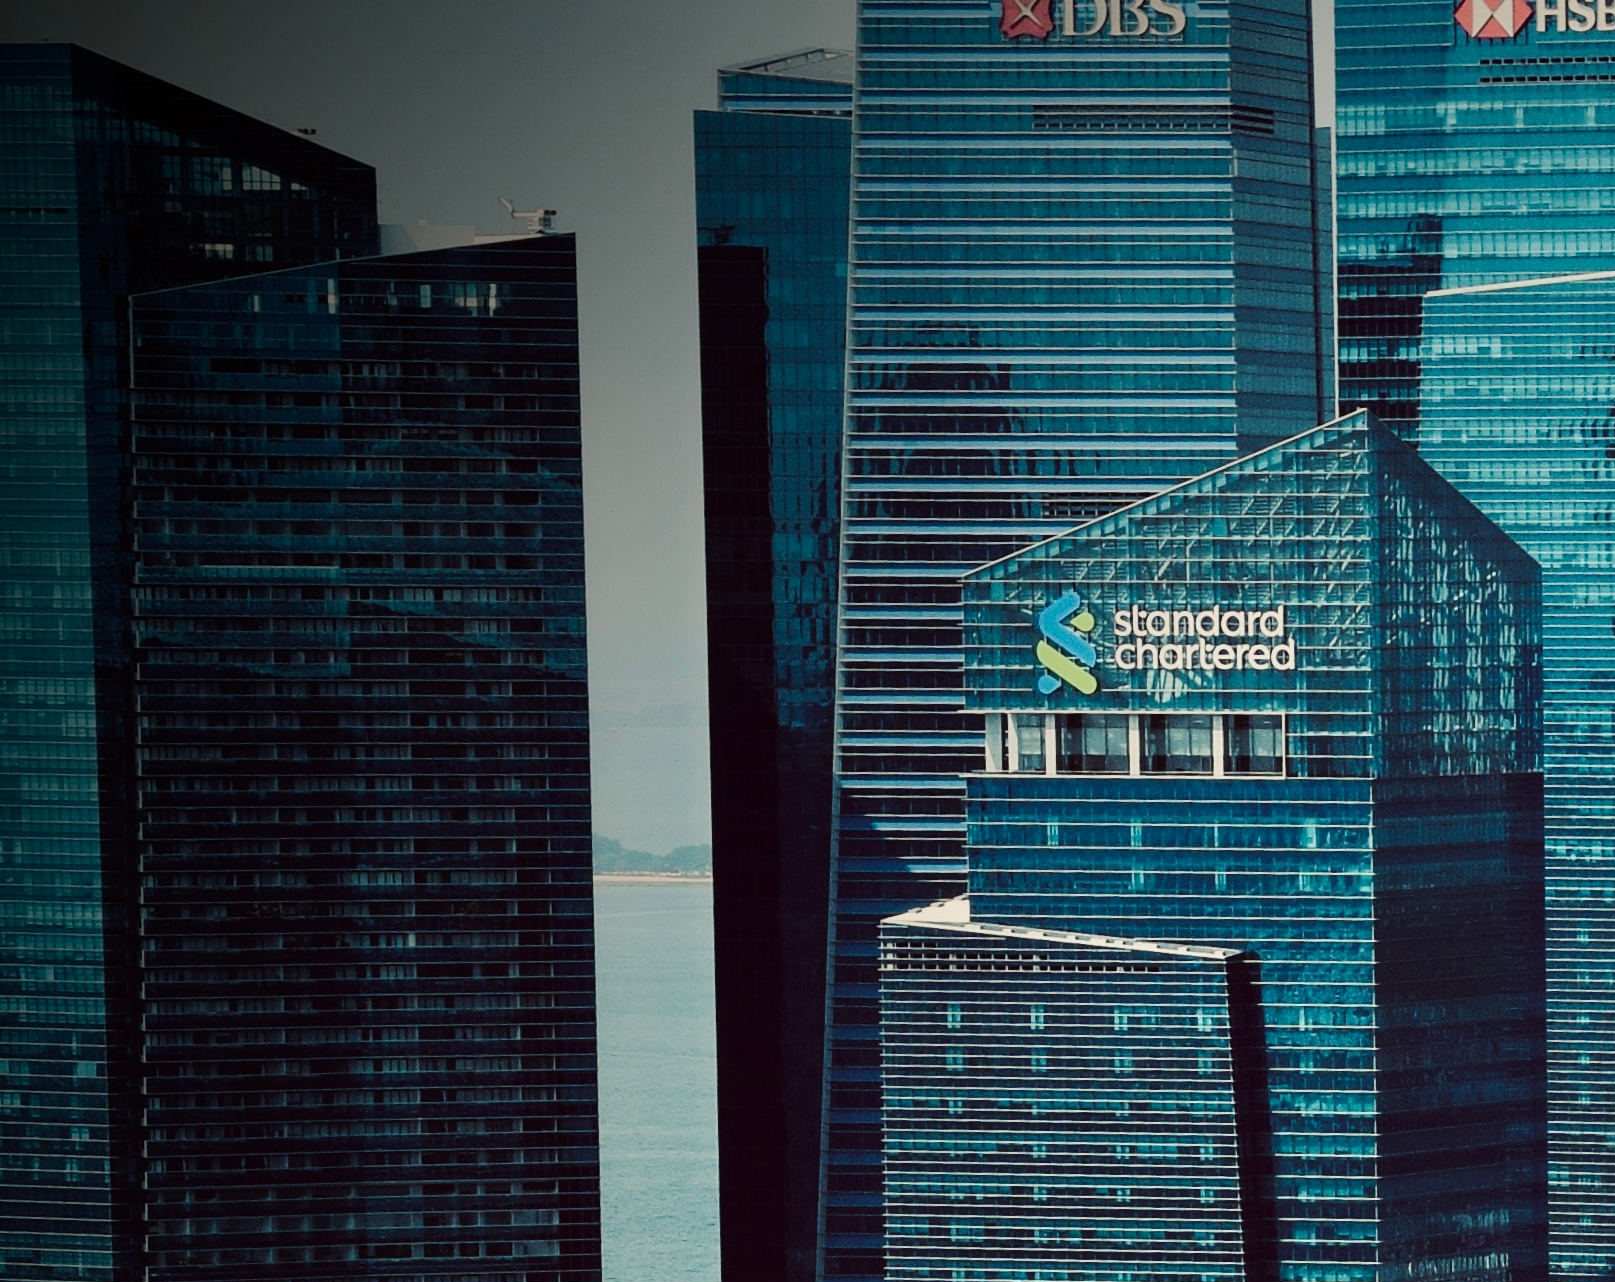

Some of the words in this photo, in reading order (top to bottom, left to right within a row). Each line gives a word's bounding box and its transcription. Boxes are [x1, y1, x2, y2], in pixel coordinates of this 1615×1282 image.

[1062, 0, 1187, 37] DBS
[1113, 604, 1285, 637] standard
[1114, 638, 1296, 670] chartered
